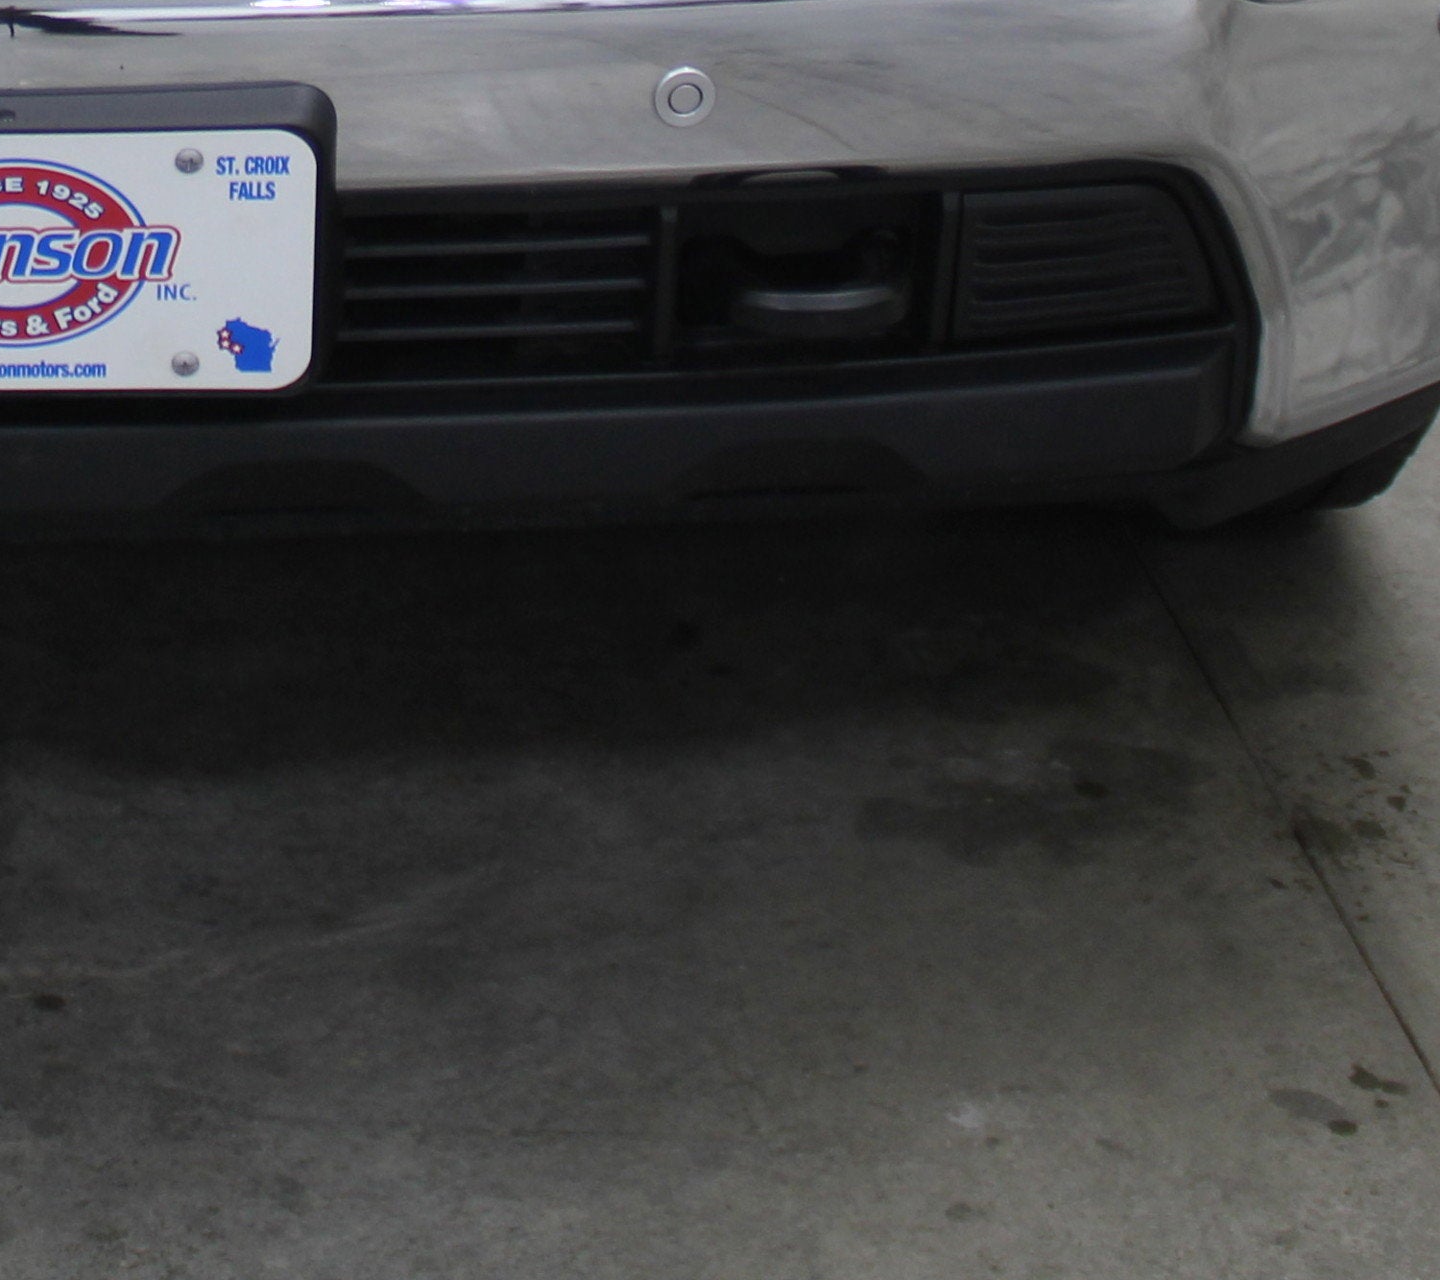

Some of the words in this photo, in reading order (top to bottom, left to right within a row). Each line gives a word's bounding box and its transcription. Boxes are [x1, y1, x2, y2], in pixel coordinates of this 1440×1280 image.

[215, 156, 239, 175] ST.
[244, 156, 290, 175] CROIX
[36, 179, 105, 219] 1925
[229, 181, 276, 200] FALLS
[156, 284, 197, 301] INC.
[25, 315, 50, 336] &
[53, 282, 118, 330] Ford
